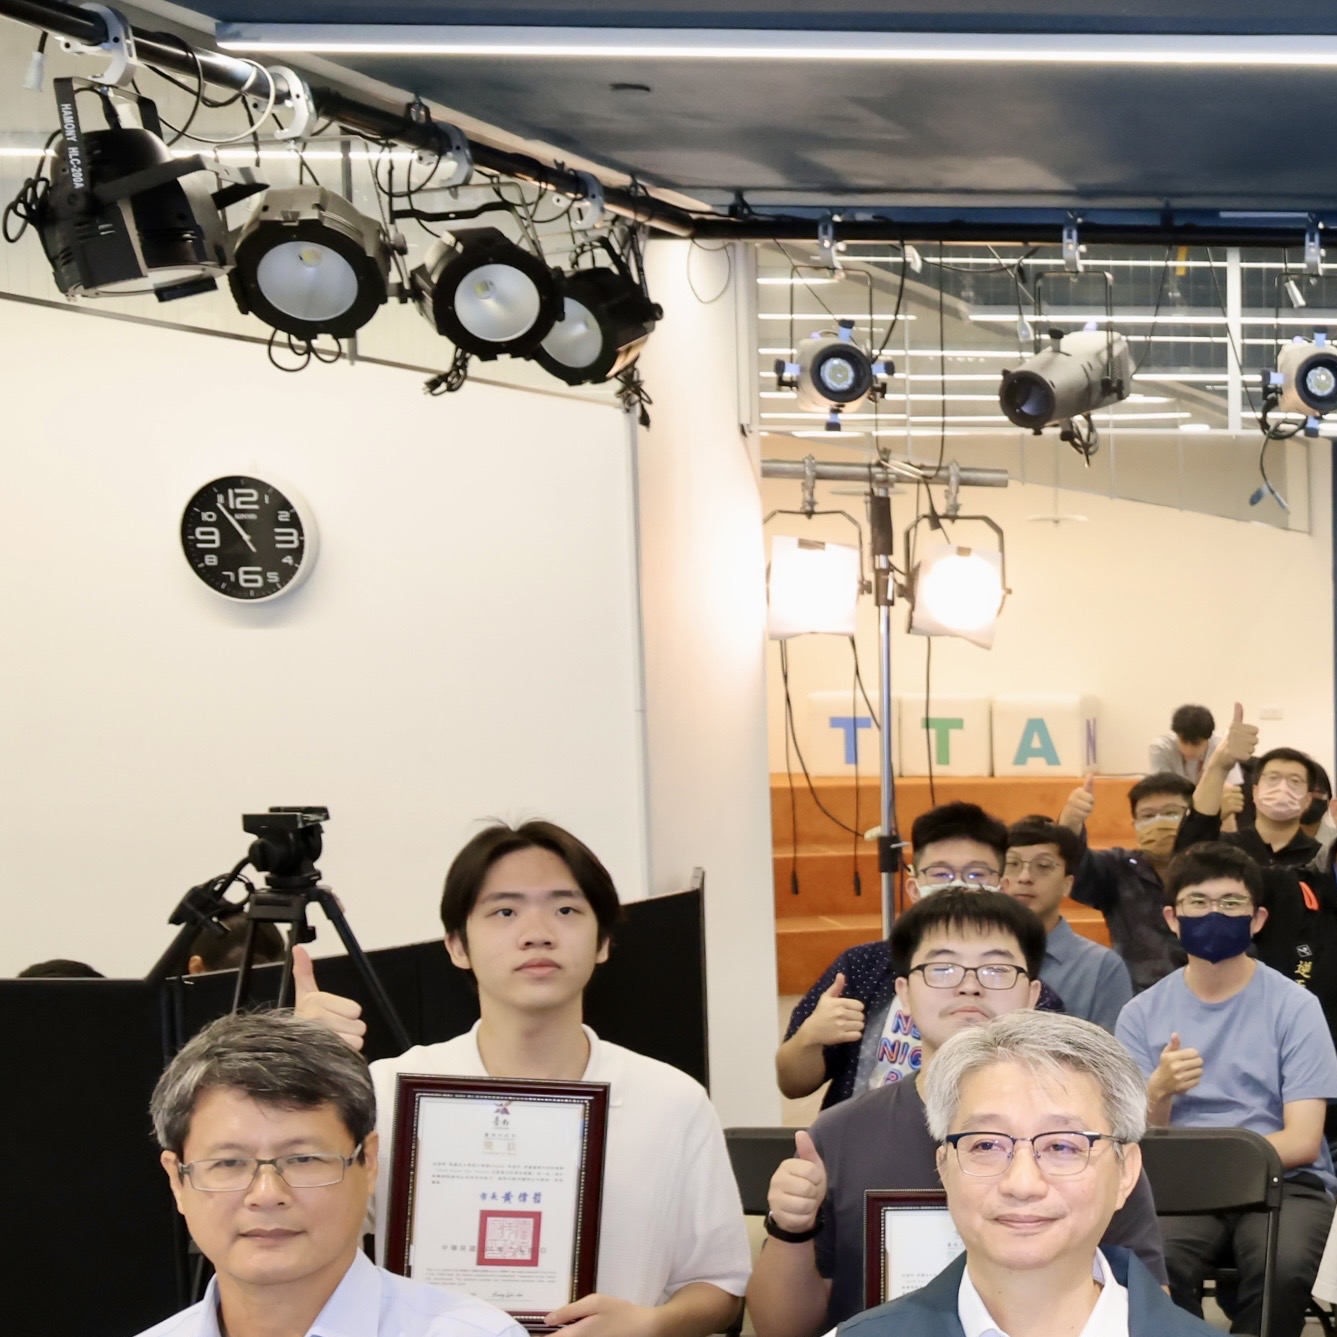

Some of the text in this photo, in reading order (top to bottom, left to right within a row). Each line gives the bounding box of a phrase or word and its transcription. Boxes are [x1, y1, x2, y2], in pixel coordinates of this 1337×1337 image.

[61, 103, 77, 142] HAMONY
[228, 488, 260, 509] 12
[264, 494, 269, 504] 1
[201, 511, 217, 522] 10
[277, 510, 290, 521] 2
[195, 527, 220, 548] 9
[274, 528, 299, 548] 3
[204, 554, 218, 566] 8
[281, 555, 294, 566] 4
[222, 571, 235, 582] 7
[238, 566, 263, 588] 6
[266, 572, 280, 583] 5
[829, 716, 1061, 766] T T A
[1086, 717, 1097, 766] N
